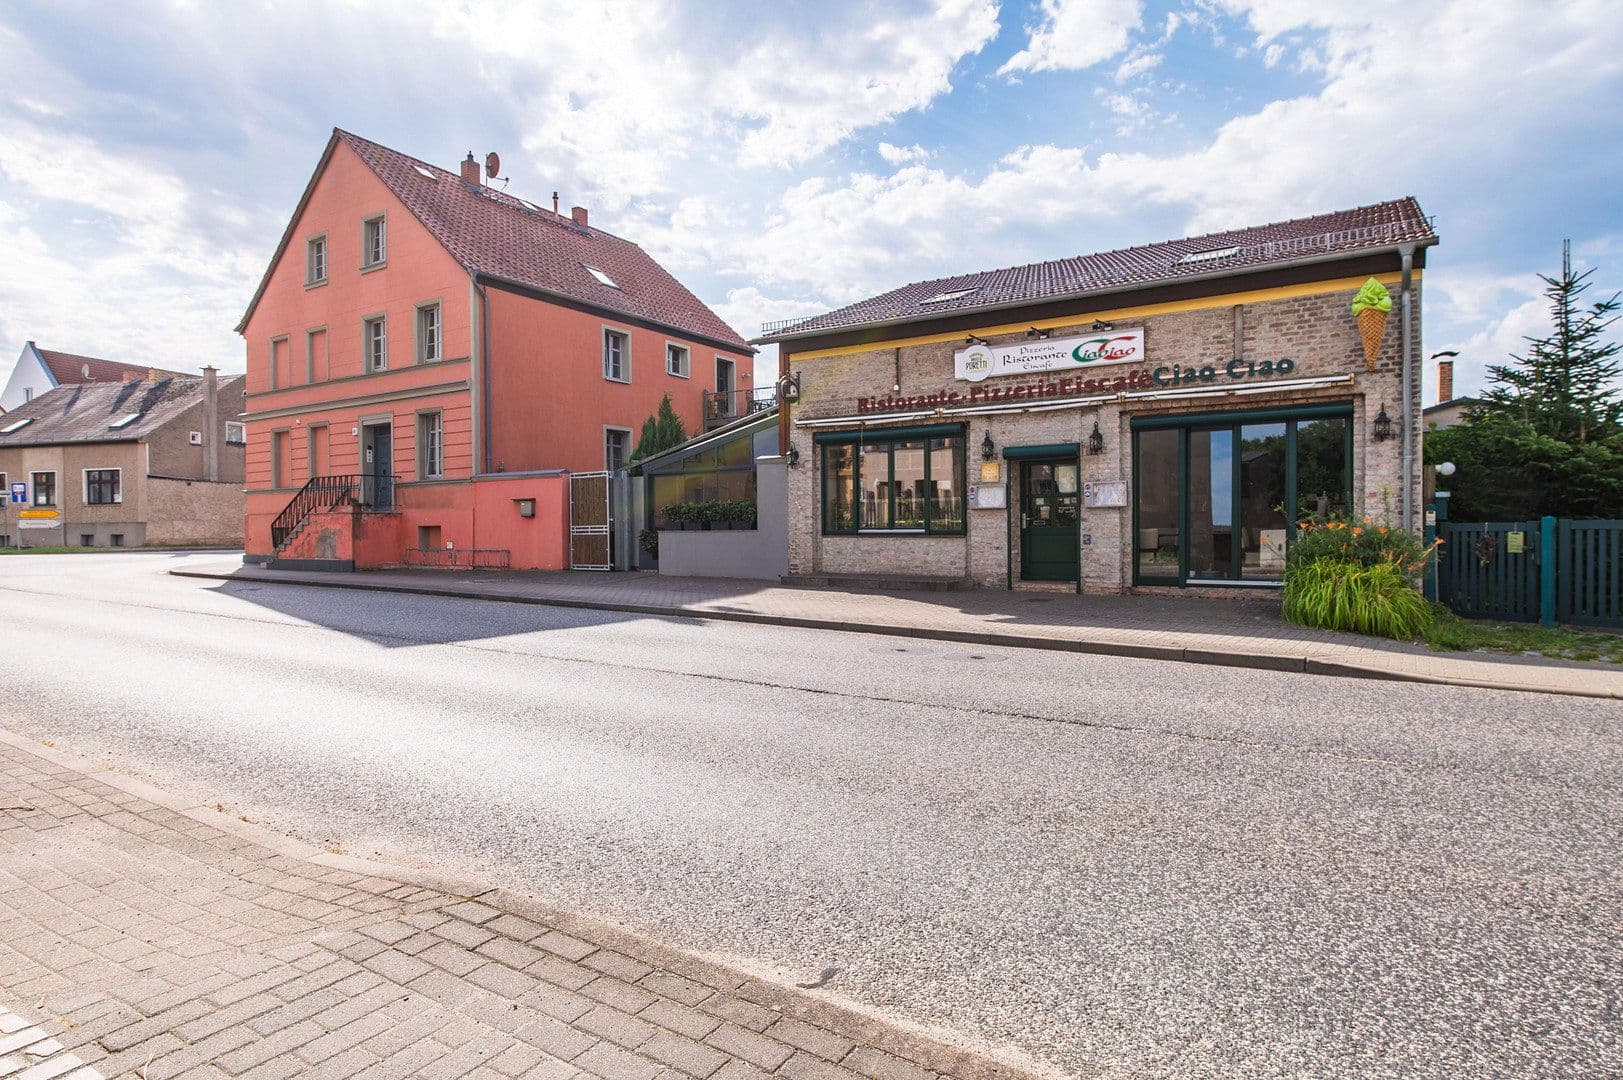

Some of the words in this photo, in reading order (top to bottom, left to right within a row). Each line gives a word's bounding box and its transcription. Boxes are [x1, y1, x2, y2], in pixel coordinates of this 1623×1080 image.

[1020, 346, 1056, 355] Pizzeria
[1002, 351, 1068, 366] Ristorante
[1152, 363, 1217, 386] Ciao
[1226, 358, 1295, 379] Ciao
